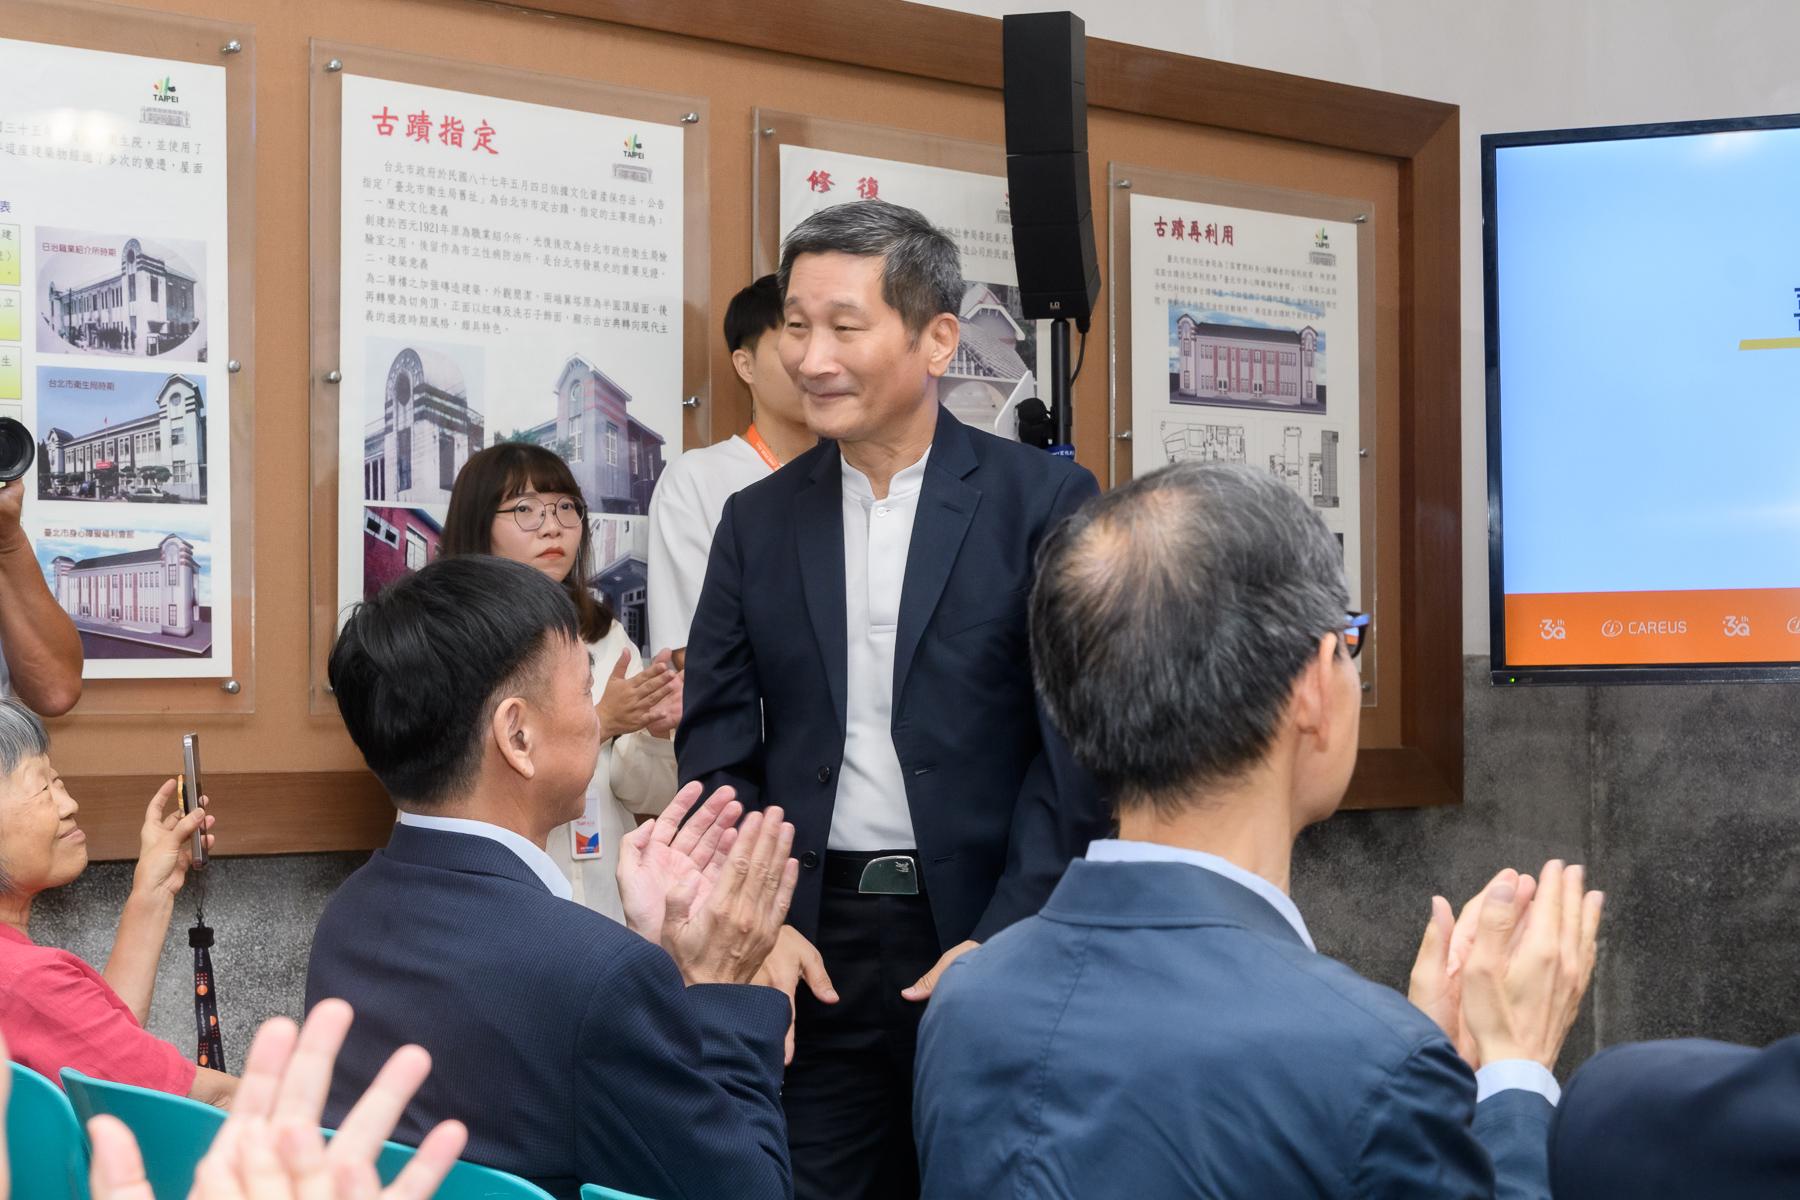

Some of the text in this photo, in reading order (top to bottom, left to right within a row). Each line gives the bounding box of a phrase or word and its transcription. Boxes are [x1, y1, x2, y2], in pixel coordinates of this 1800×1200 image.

[153, 94, 179, 103] TAIPEI
[371, 106, 500, 154] 古蹟指定
[1154, 215, 1234, 246] 古蹟再利用
[1628, 621, 1687, 634] CAREUS
